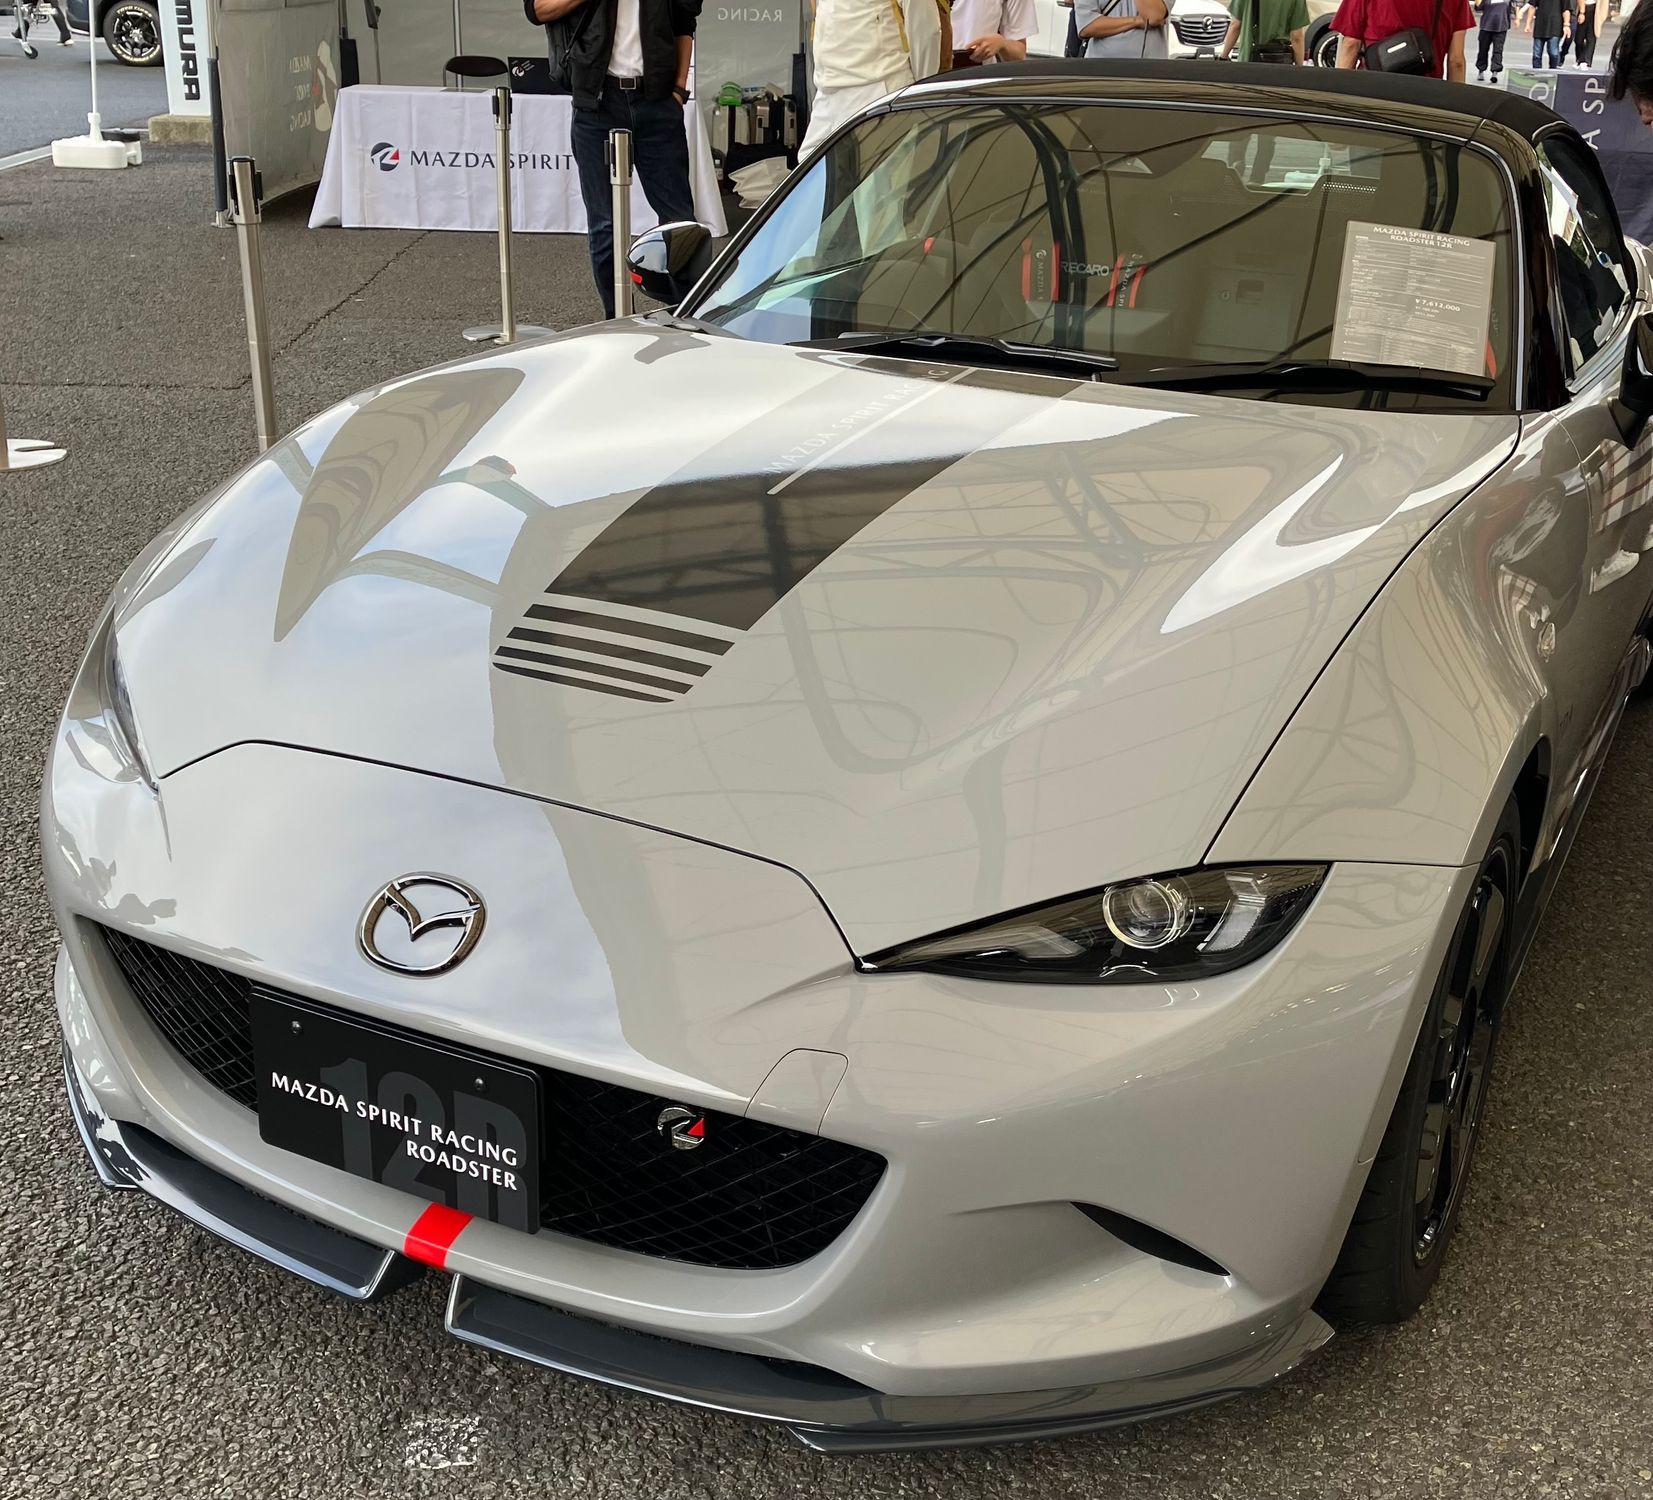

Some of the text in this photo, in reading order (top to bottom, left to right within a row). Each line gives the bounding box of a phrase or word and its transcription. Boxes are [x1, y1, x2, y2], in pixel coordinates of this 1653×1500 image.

[410, 150, 573, 170] MAZDA SPIRIT
[1373, 226, 1470, 246] MAZDA SPIRIT RACING
[1390, 234, 1453, 249] ROADSTER 12R
[1061, 261, 1110, 276] RECARO
[764, 431, 840, 474] MAZDA
[271, 1071, 517, 1166] MAZDA SPIRIT RACING
[406, 1140, 517, 1191] ROADSTER
